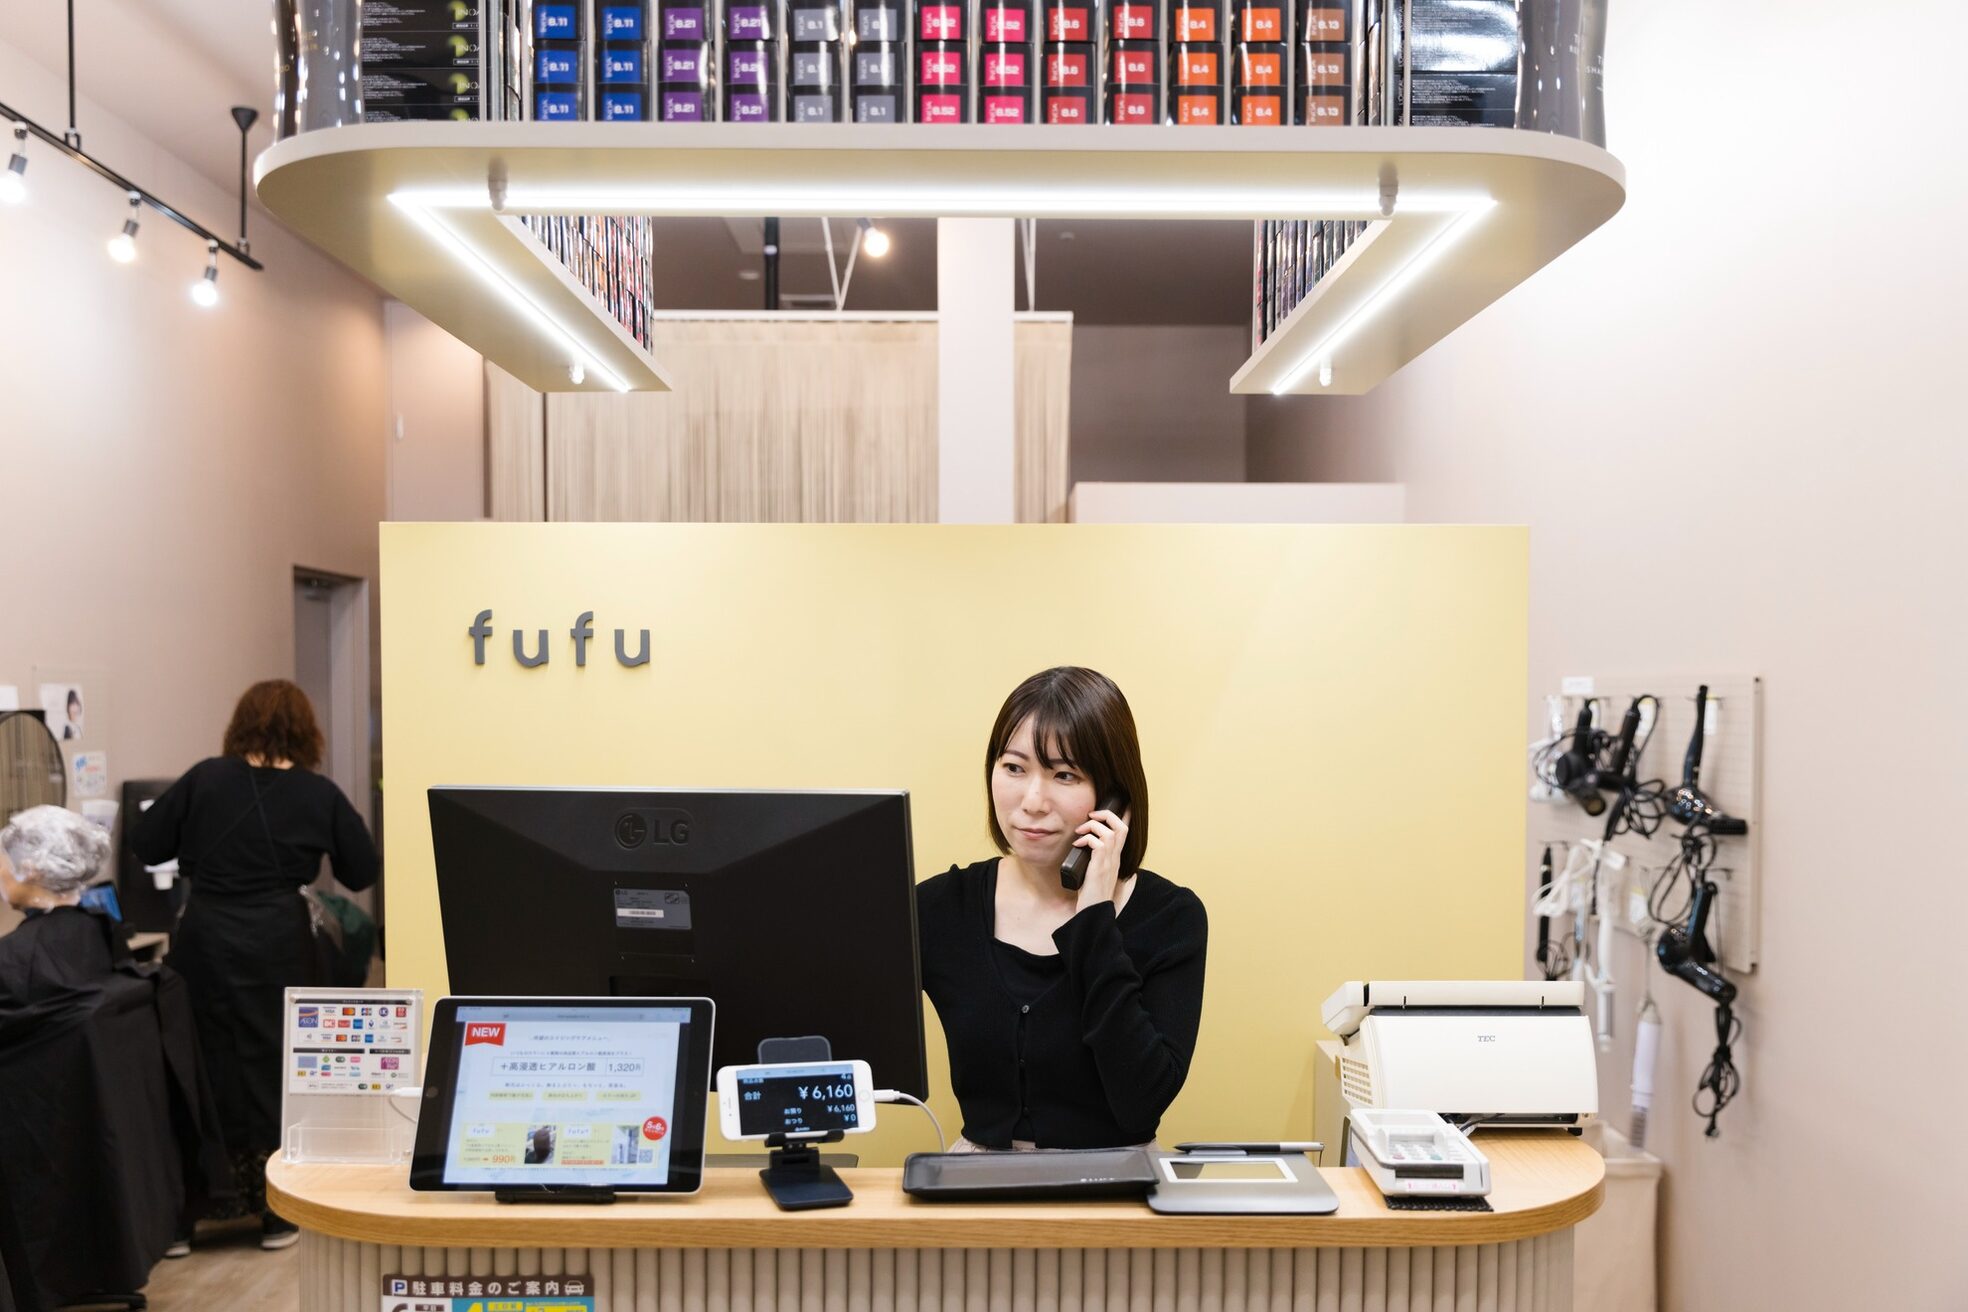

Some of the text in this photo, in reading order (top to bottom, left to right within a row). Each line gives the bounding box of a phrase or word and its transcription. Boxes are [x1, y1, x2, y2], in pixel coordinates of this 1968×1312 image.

[469, 609, 650, 668] fufu
[653, 820, 689, 845] LG
[472, 1027, 500, 1037] NEW
[743, 1084, 853, 1101] 合計 ¥6,160
[412, 1281, 559, 1296] 駐車料金のご案内
